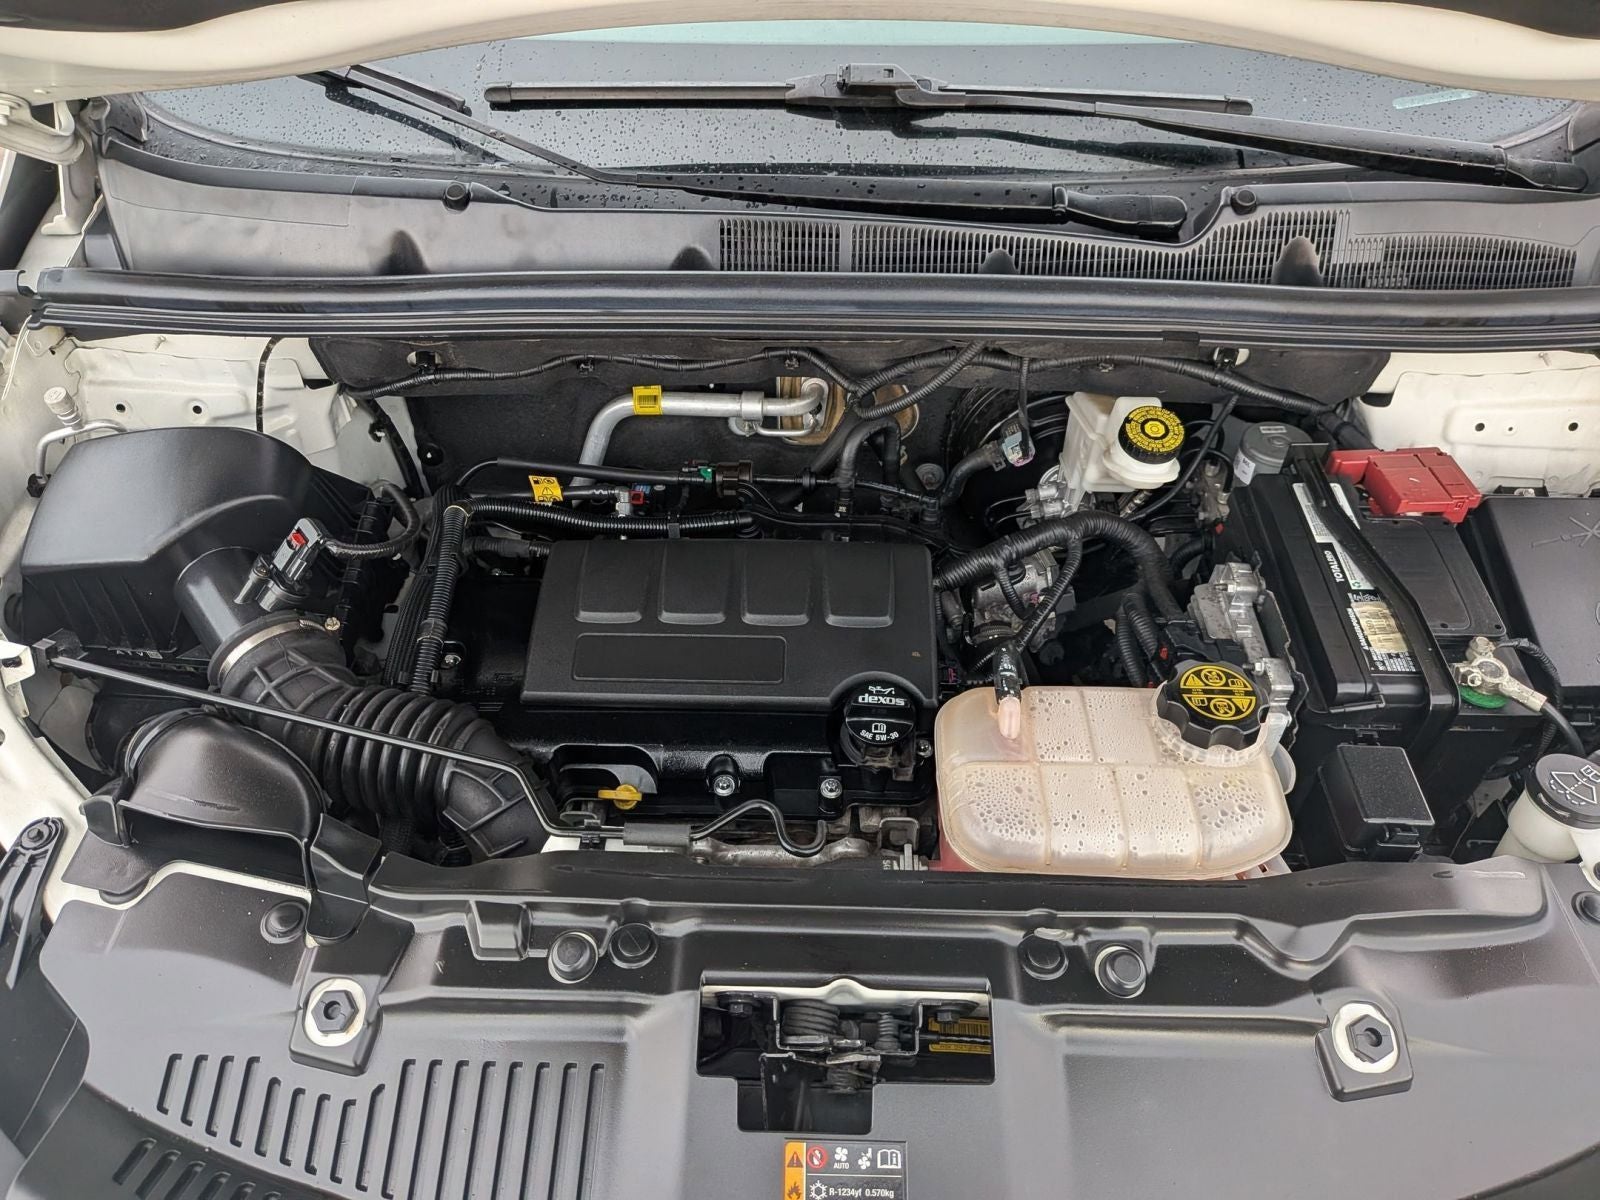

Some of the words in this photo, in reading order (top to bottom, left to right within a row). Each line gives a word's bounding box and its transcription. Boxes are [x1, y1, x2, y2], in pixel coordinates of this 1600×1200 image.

[858, 693, 905, 706] dexos
[860, 729, 874, 740] SAE
[875, 731, 899, 741] 5W-30
[833, 1162, 850, 1170] AUTO
[829, 1187, 862, 1198] R-1234yf
[865, 1188, 895, 1198] 0.570kg
